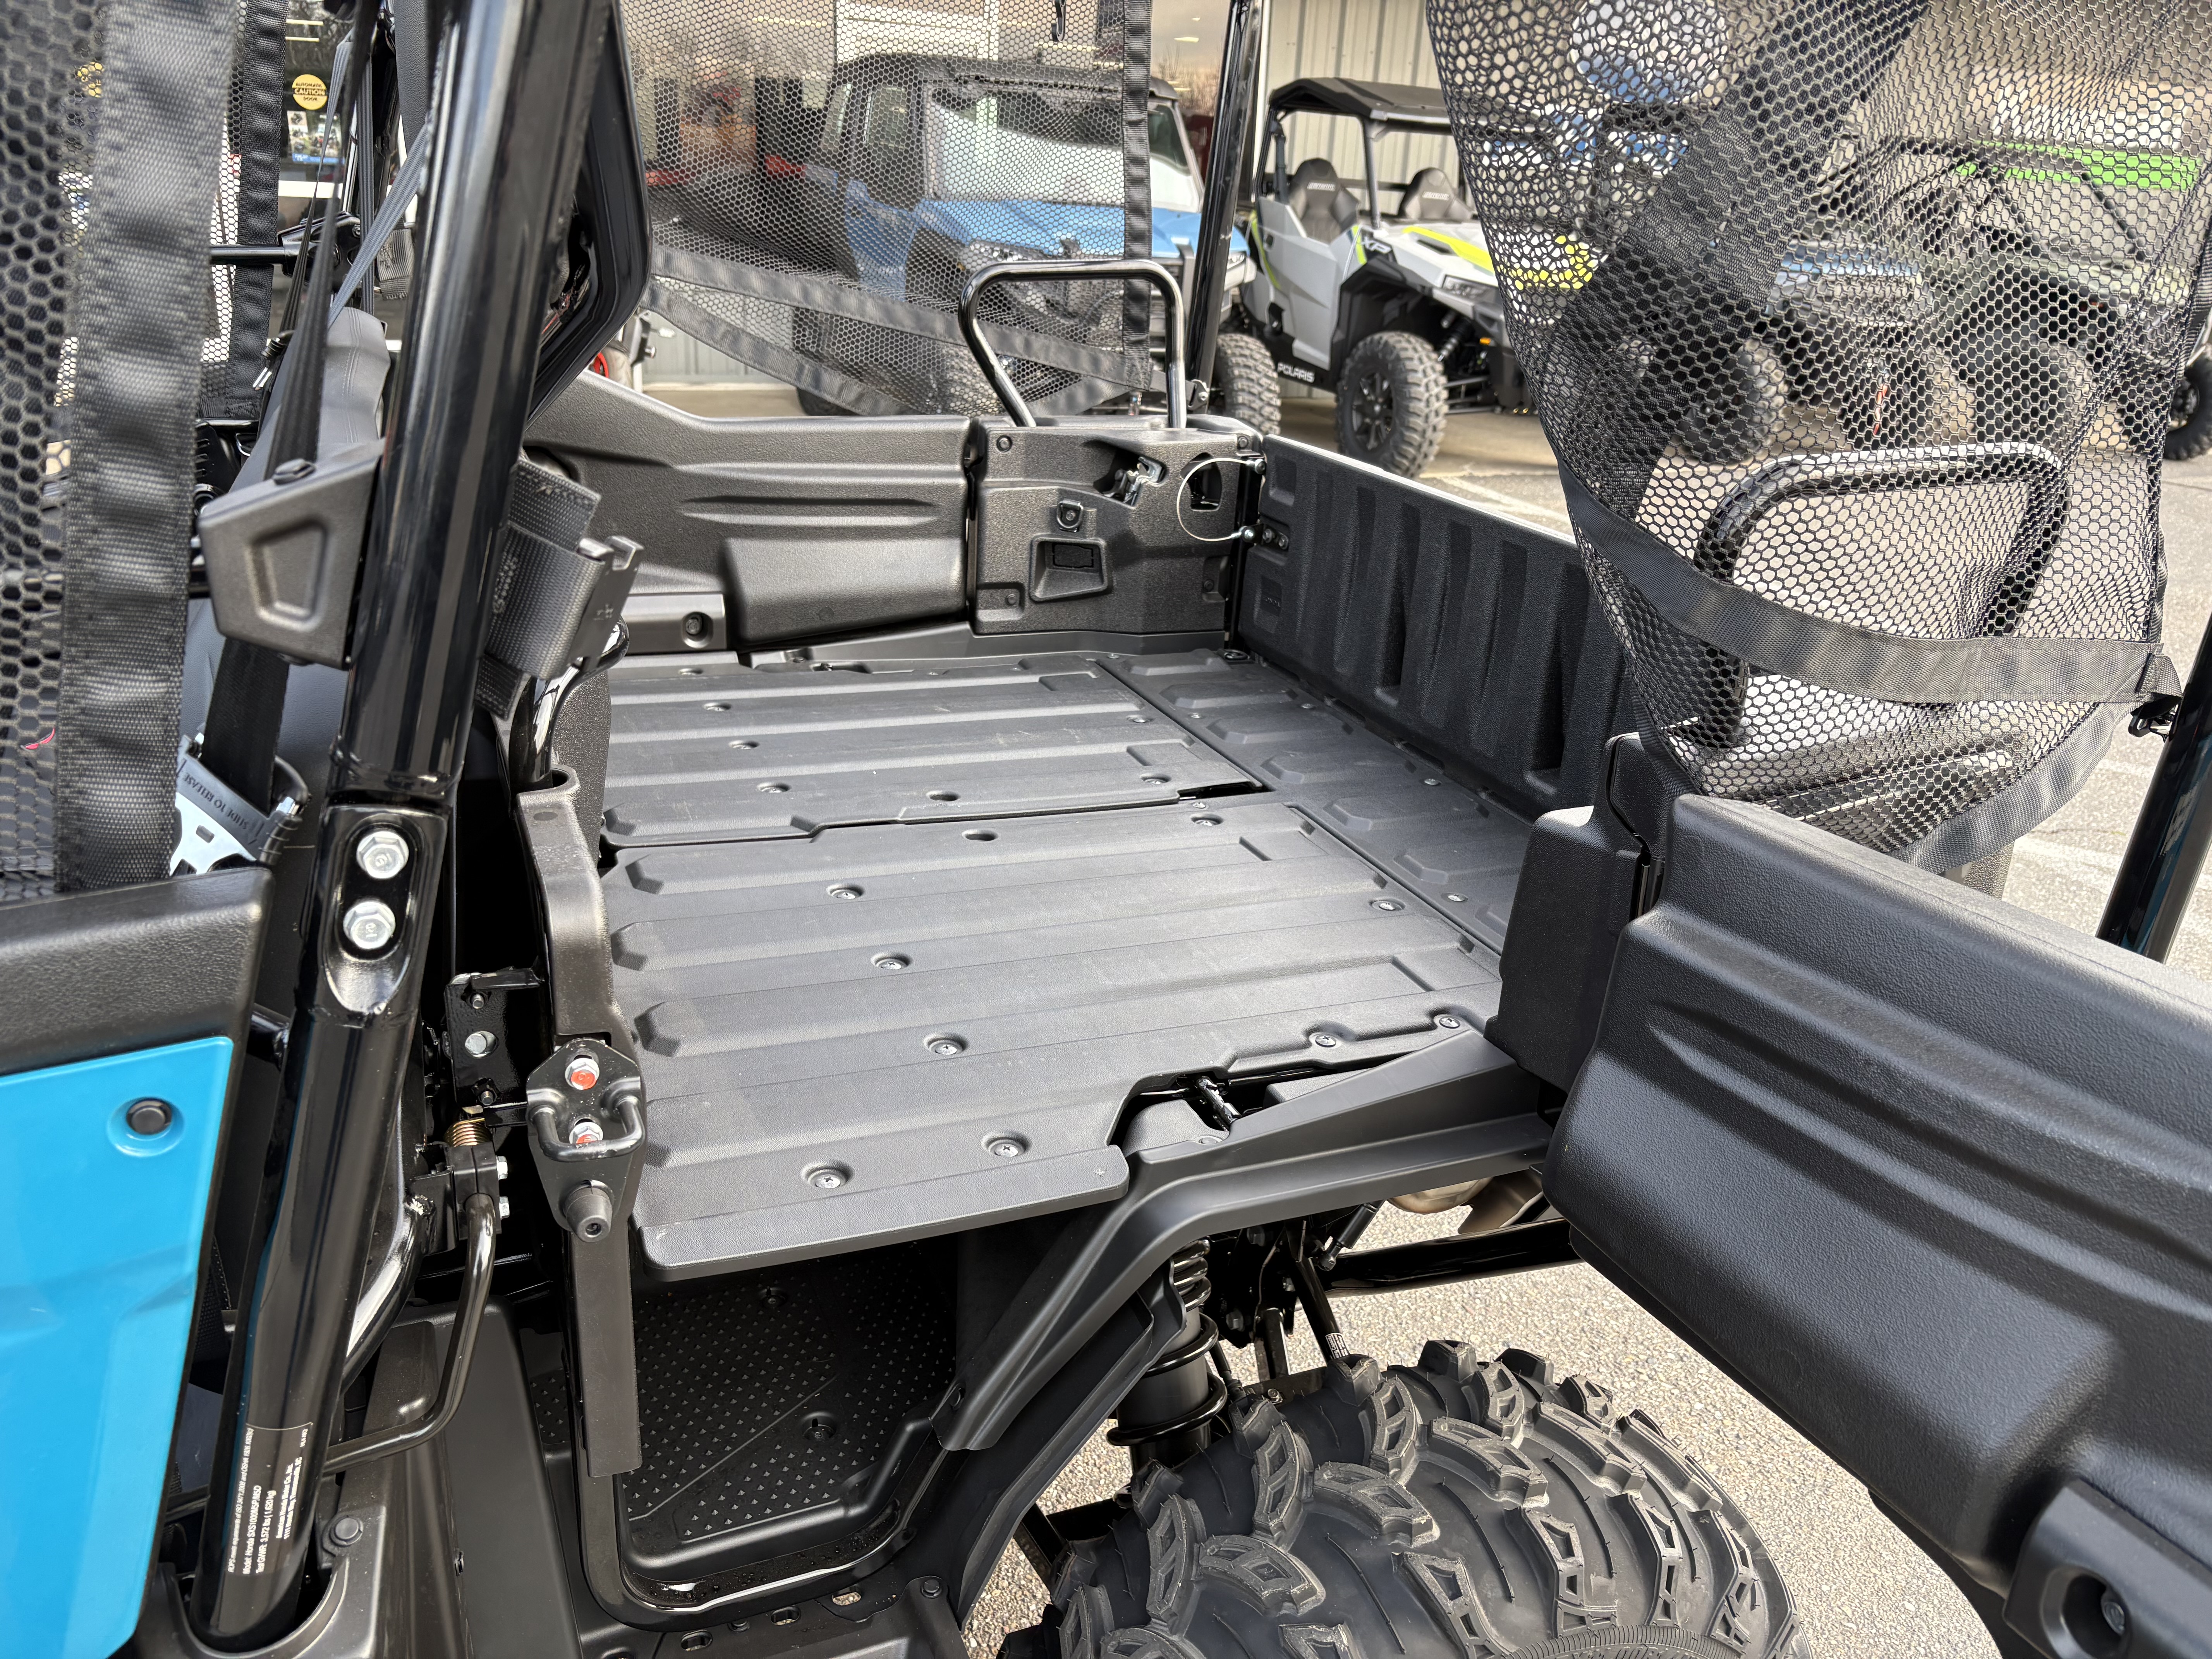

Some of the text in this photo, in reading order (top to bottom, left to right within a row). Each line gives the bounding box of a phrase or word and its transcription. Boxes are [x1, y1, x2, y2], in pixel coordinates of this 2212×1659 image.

[1362, 236, 1392, 254] XP
[1278, 362, 1315, 383] POLARIS
[214, 799, 225, 812] TO
